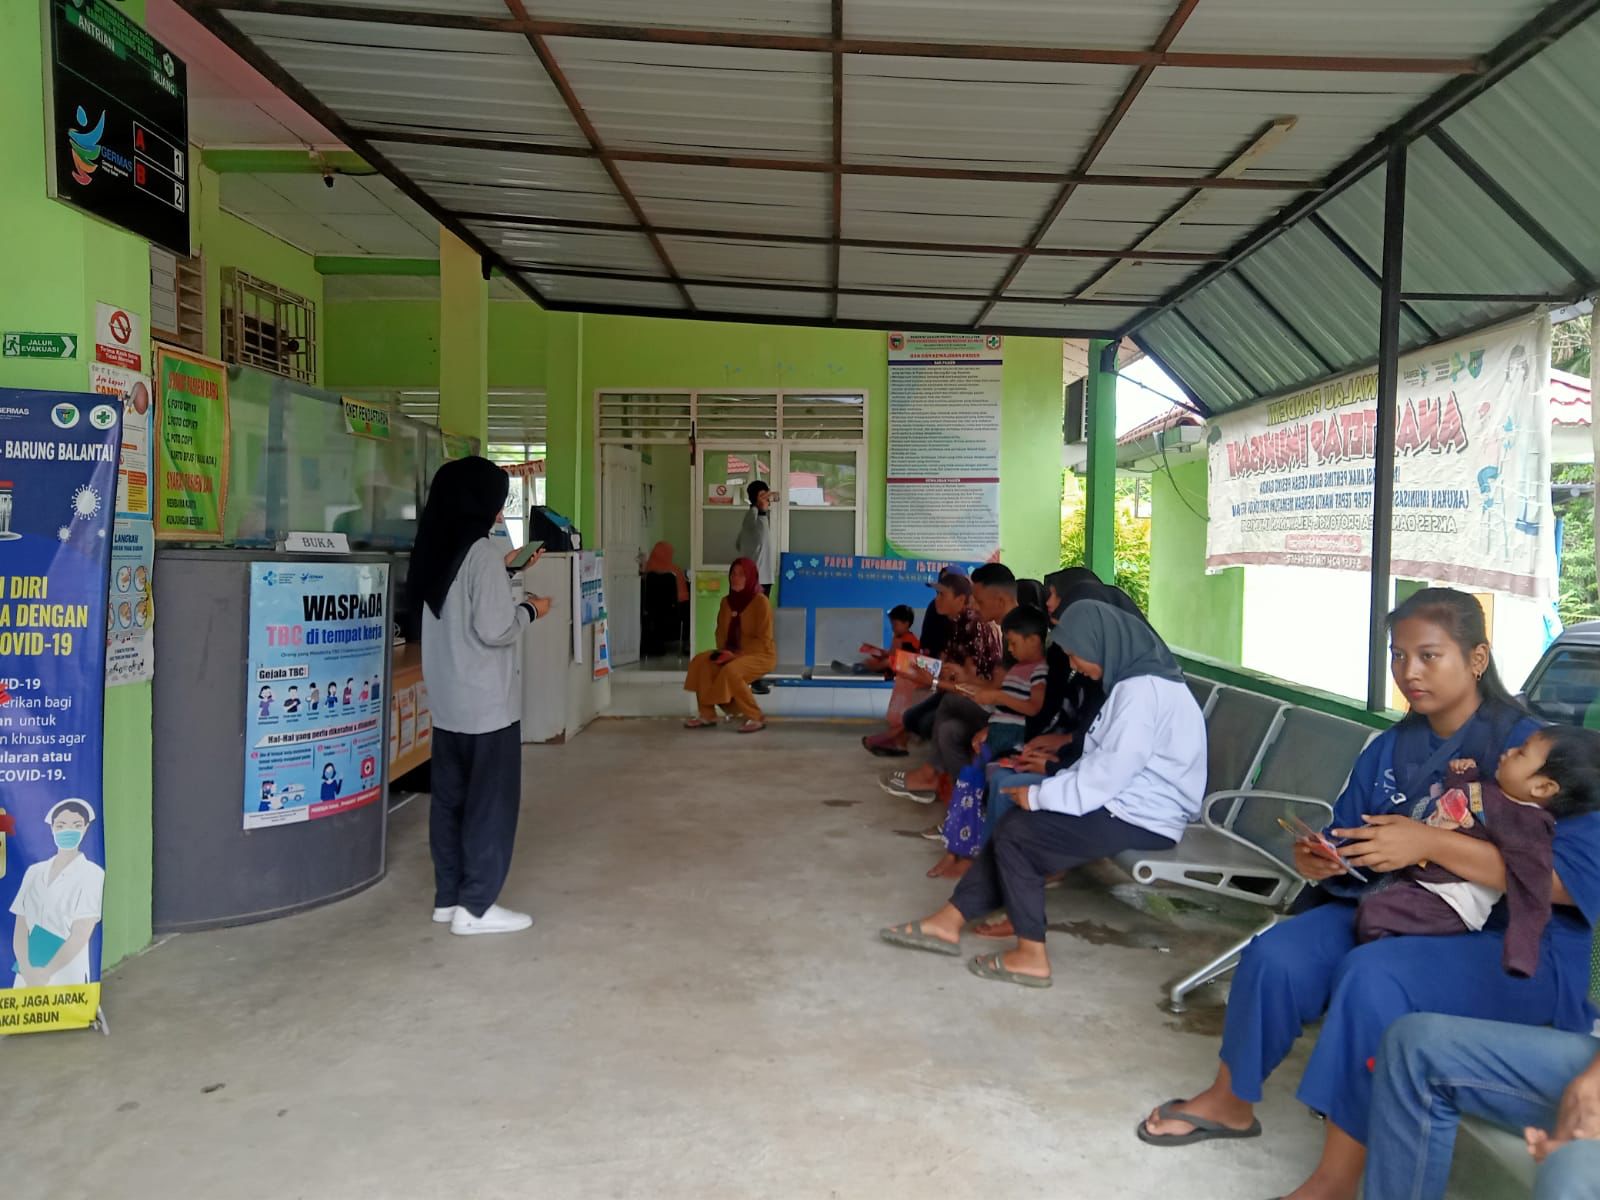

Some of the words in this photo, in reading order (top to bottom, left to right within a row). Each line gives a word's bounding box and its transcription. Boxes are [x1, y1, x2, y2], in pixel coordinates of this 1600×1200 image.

[79, 15, 115, 53] ANTRIAN
[153, 70, 177, 97] RUANG
[136, 128, 146, 151] A
[102, 146, 133, 173] GERMAS
[176, 154, 182, 174] 1
[136, 162, 146, 185] B
[176, 186, 182, 206] 2
[28, 339, 53, 347] JALUR
[0, 407, 30, 416] ERMAS
[5, 440, 55, 461] BARUNG
[58, 442, 114, 462] BALANTAI
[302, 536, 336, 549] BUKA
[10, 576, 48, 599] DIRI
[16, 604, 88, 628] DENGAN
[303, 593, 382, 622] WASPADA
[0, 632, 73, 657] OVID-19
[265, 624, 304, 648] TBC
[306, 628, 320, 646] di
[321, 628, 362, 645] tempat
[362, 623, 383, 641] kerja
[259, 669, 288, 680] Gejala
[44, 695, 73, 712] bagi
[19, 714, 57, 727] untuk
[11, 731, 56, 745] khusus
[58, 732, 87, 747] agar
[268, 733, 296, 745] Hal-Hal
[41, 750, 73, 763] atau
[22, 995, 50, 1008] JAGA
[52, 992, 88, 1006] JARAK,
[23, 1011, 60, 1025] SABUN
